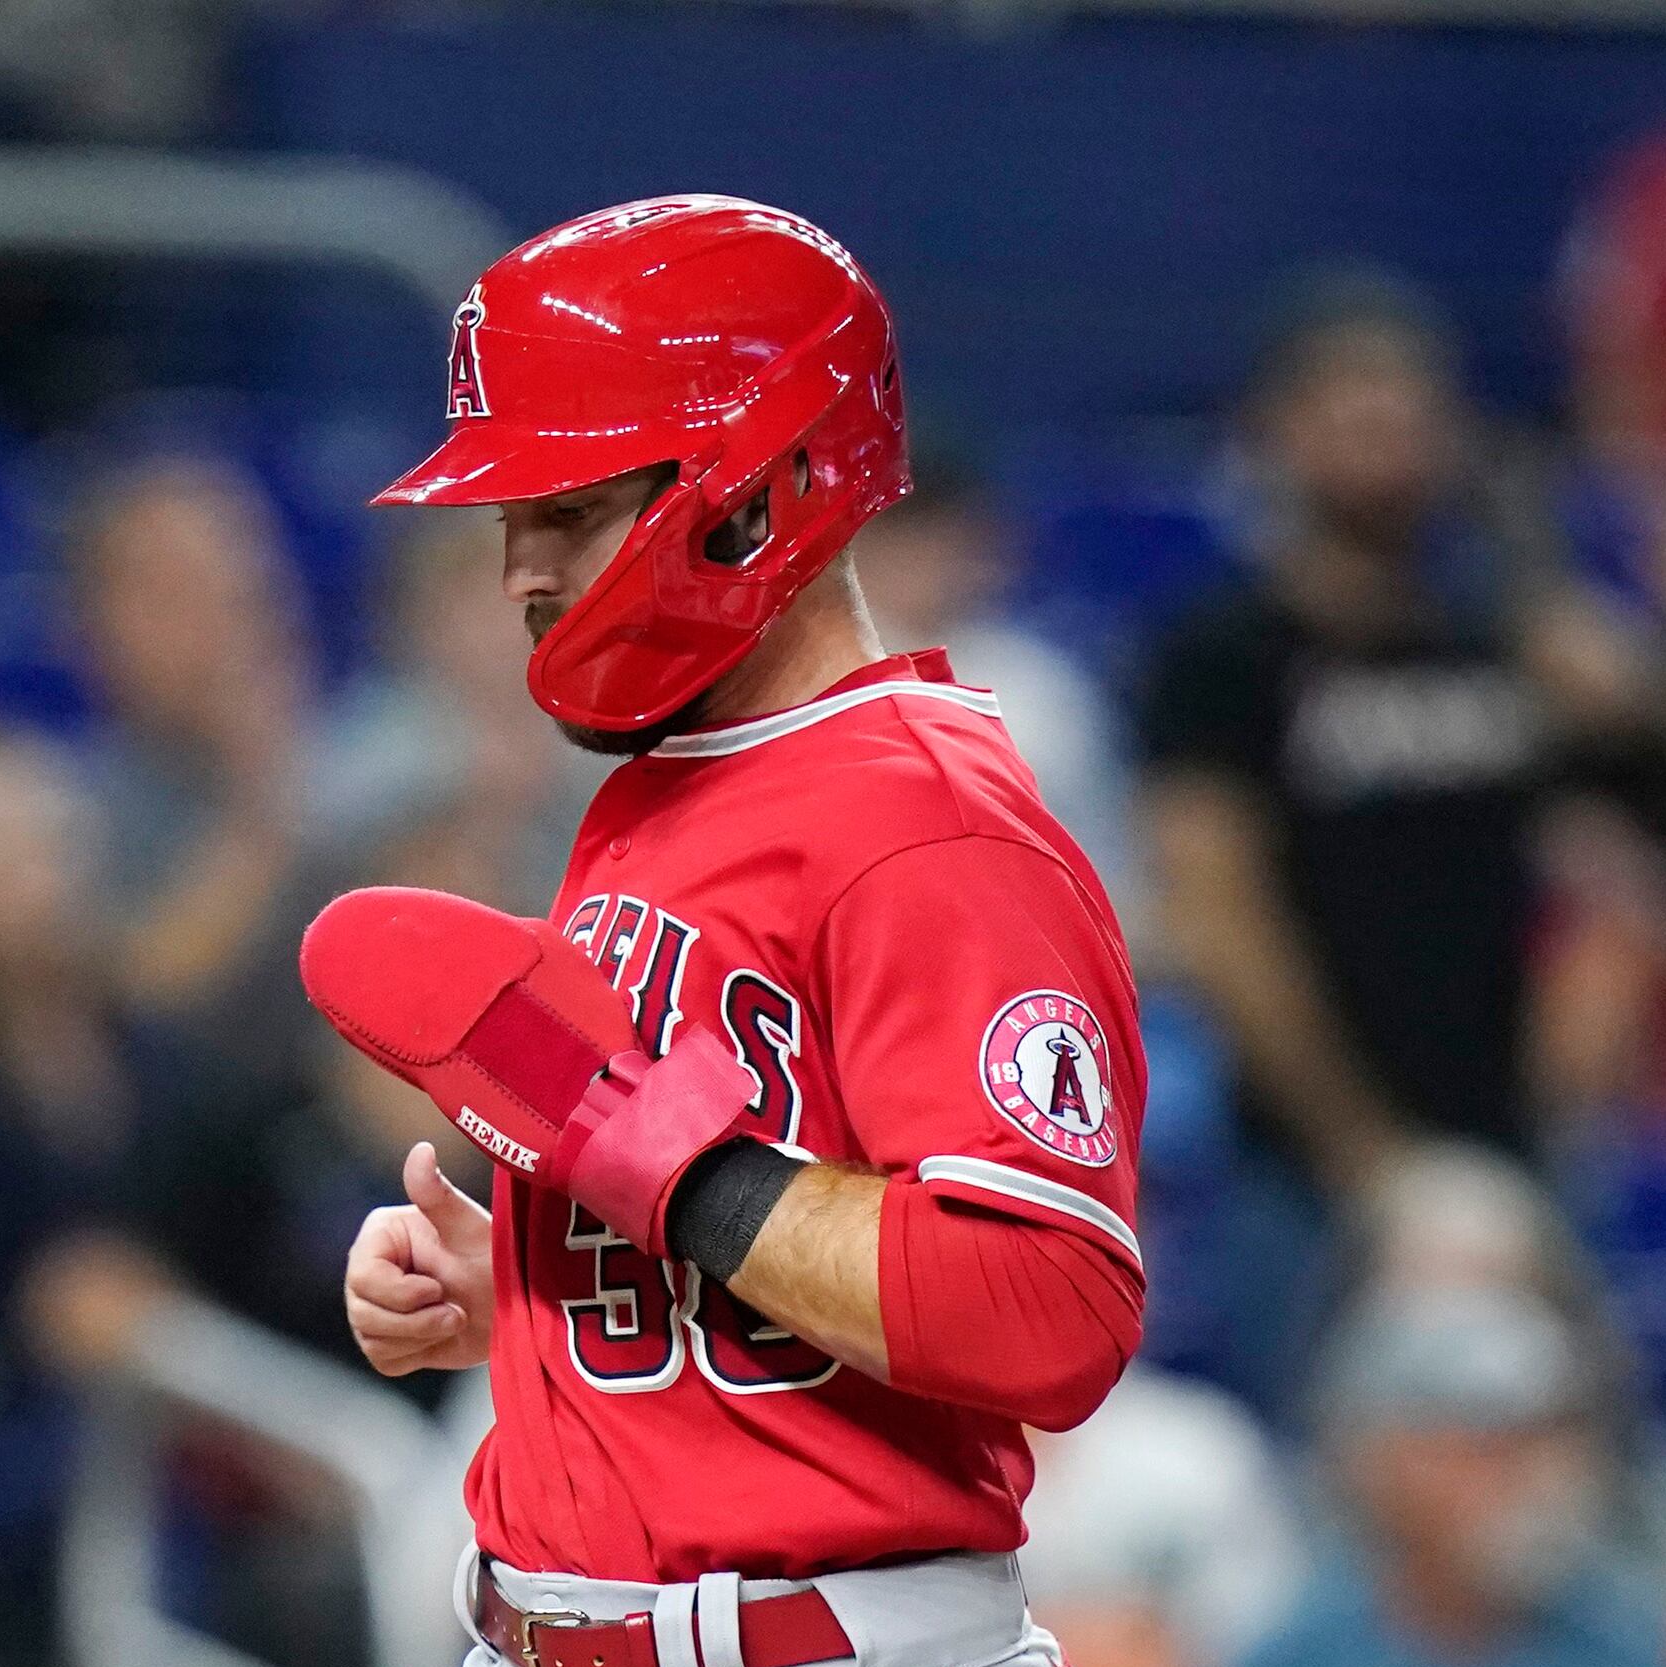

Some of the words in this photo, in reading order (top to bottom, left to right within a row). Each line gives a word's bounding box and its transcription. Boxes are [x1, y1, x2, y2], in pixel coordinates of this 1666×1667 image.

[445, 283, 493, 419] A
[1004, 998, 1102, 1051] ANGELS
[455, 1105, 541, 1174] BENIK
